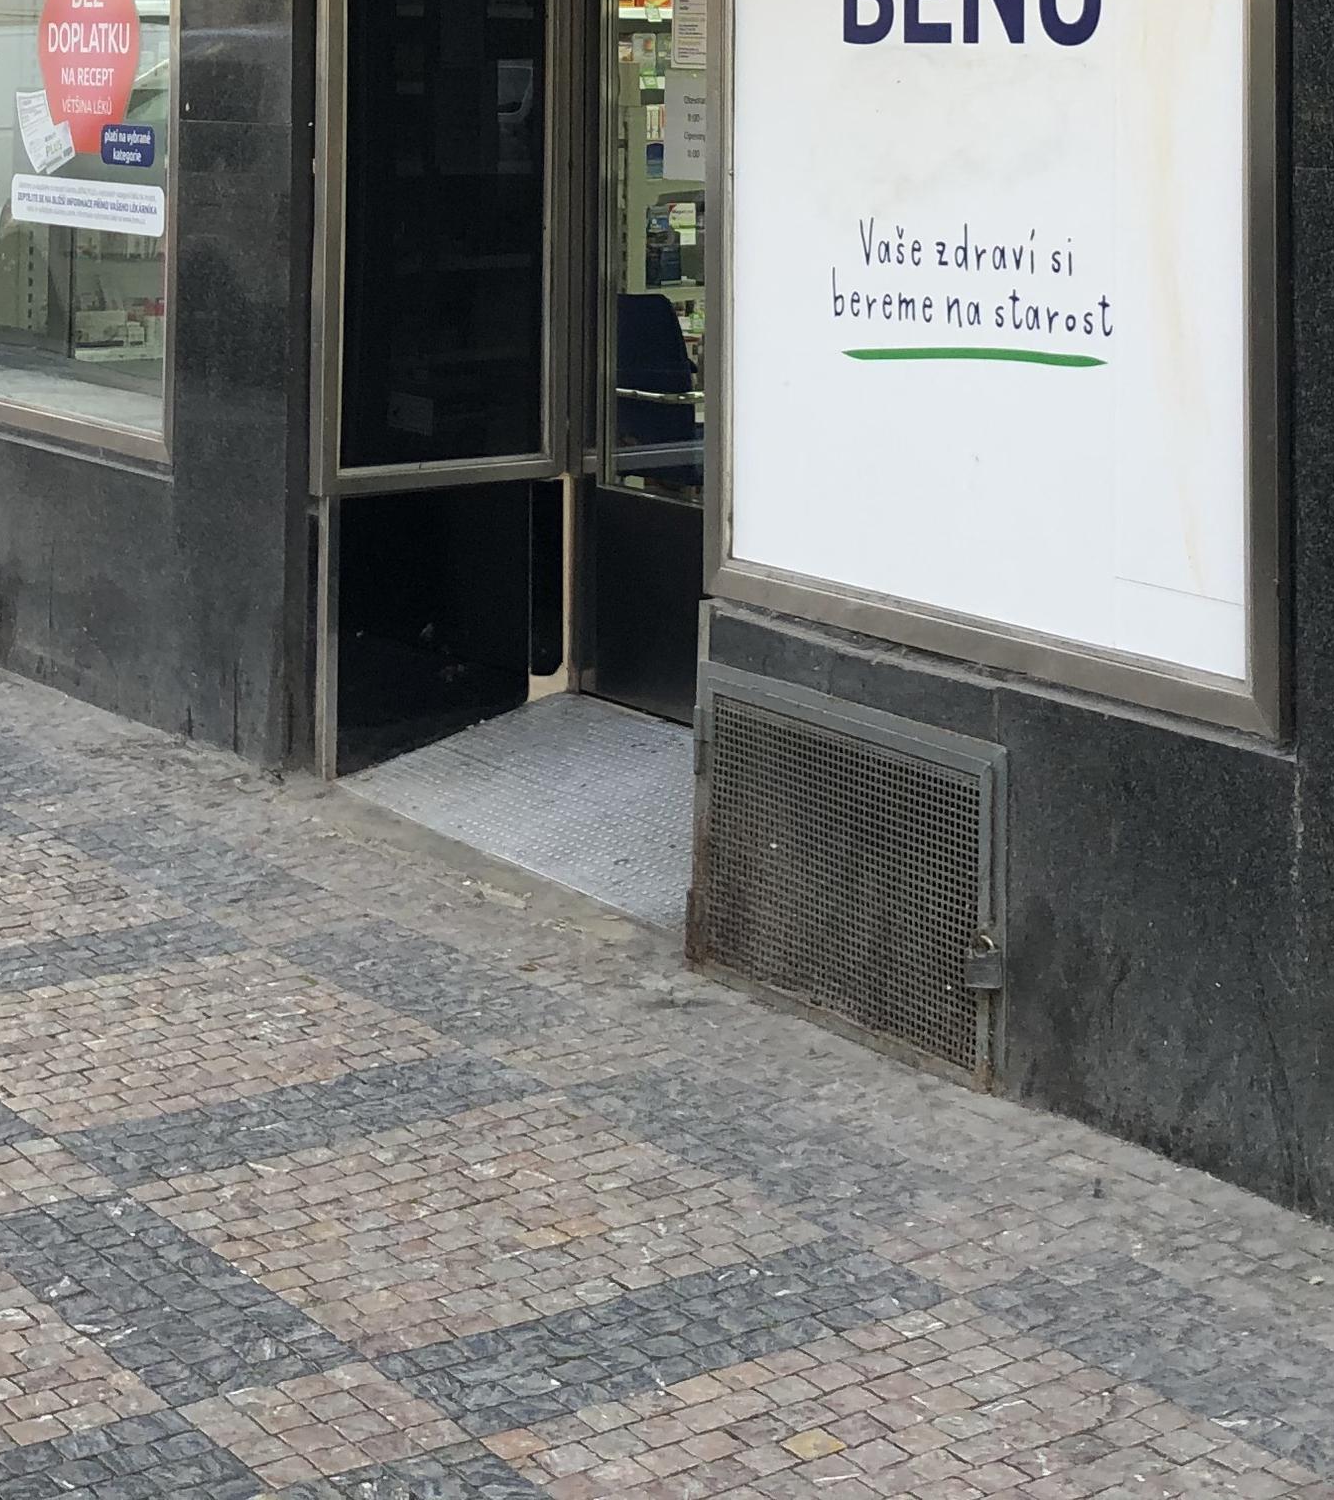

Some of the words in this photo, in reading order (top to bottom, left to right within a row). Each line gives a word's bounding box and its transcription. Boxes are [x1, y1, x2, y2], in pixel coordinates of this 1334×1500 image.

[48, 22, 130, 54] DOPLATKU
[61, 68, 75, 86] NA
[78, 68, 114, 87] RECEPT
[859, 217, 922, 266] Vaše
[935, 223, 1036, 274] zdraví
[1051, 238, 1073, 276] si
[832, 267, 933, 323] bereme
[946, 295, 981, 328] na
[994, 289, 1113, 337] starost
